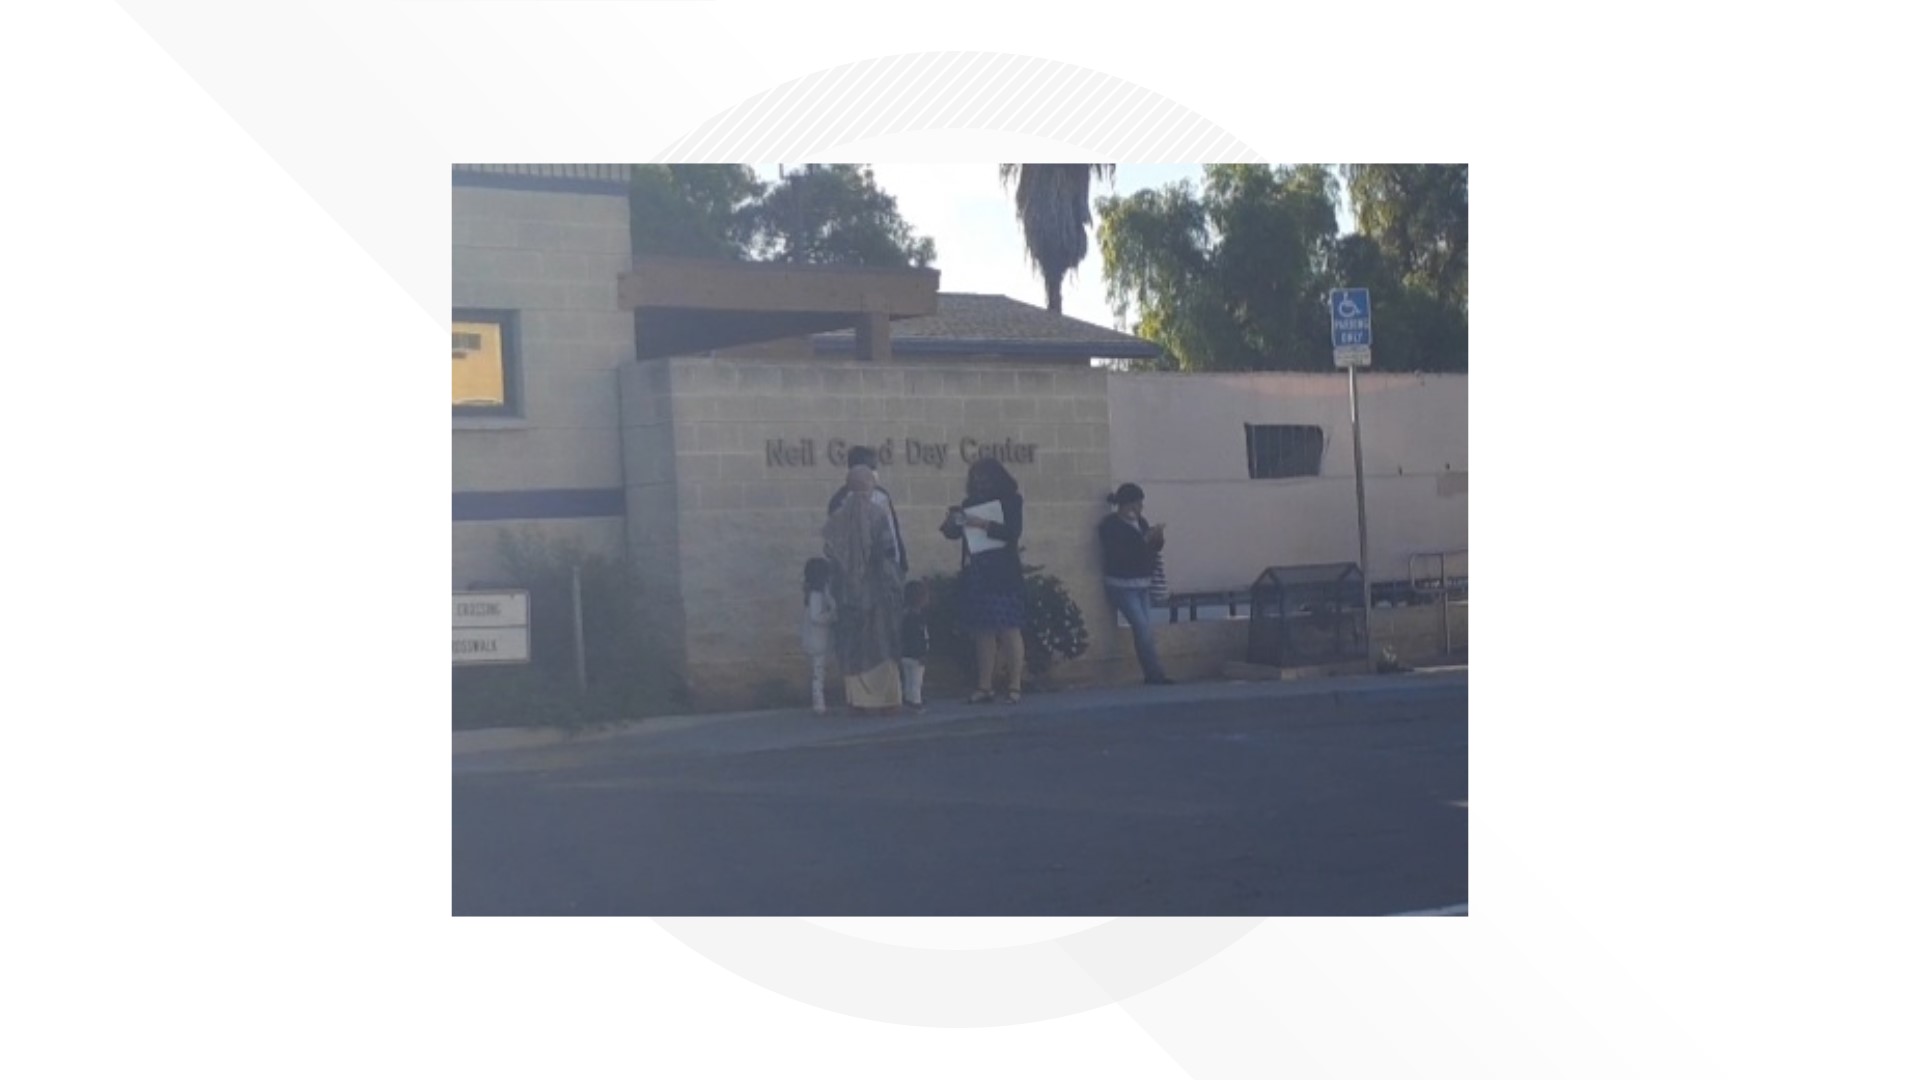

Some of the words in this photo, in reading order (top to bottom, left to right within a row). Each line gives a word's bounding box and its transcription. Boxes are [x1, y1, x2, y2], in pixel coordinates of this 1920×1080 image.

[765, 438, 815, 467] Neil
[827, 436, 894, 468] Gd
[905, 437, 949, 469] Day
[959, 436, 1038, 465] Center
